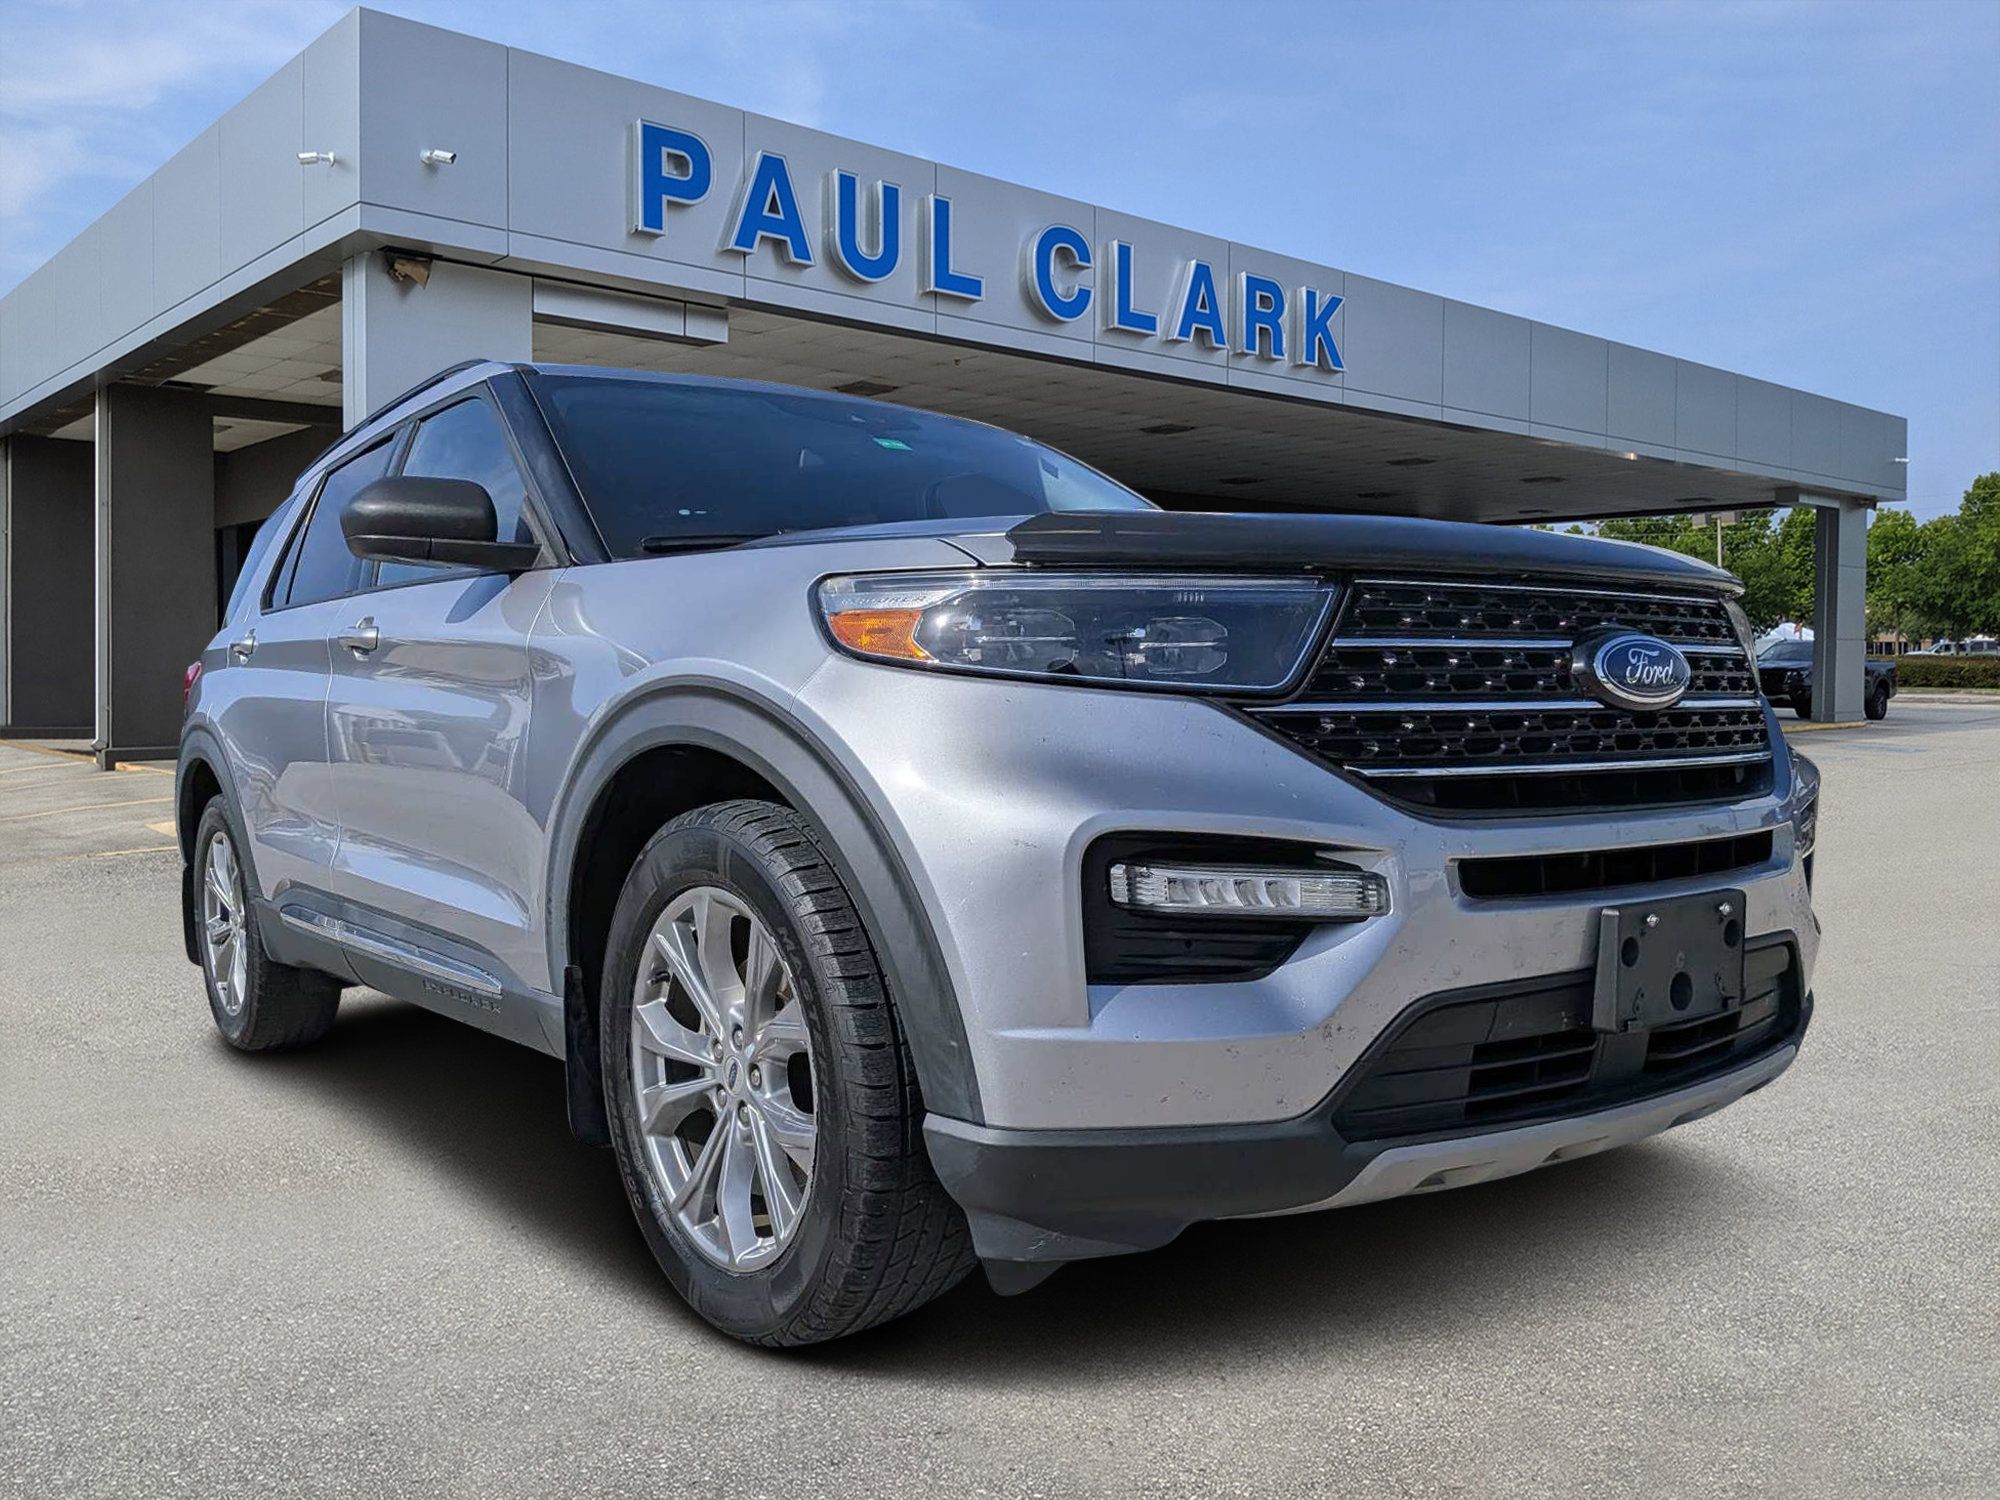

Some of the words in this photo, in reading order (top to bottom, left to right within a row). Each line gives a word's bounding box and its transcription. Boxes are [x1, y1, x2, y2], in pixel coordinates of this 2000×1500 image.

[632, 118, 985, 301] PAUL
[1027, 222, 1346, 373] CLARK
[1625, 647, 1678, 685] Ford
